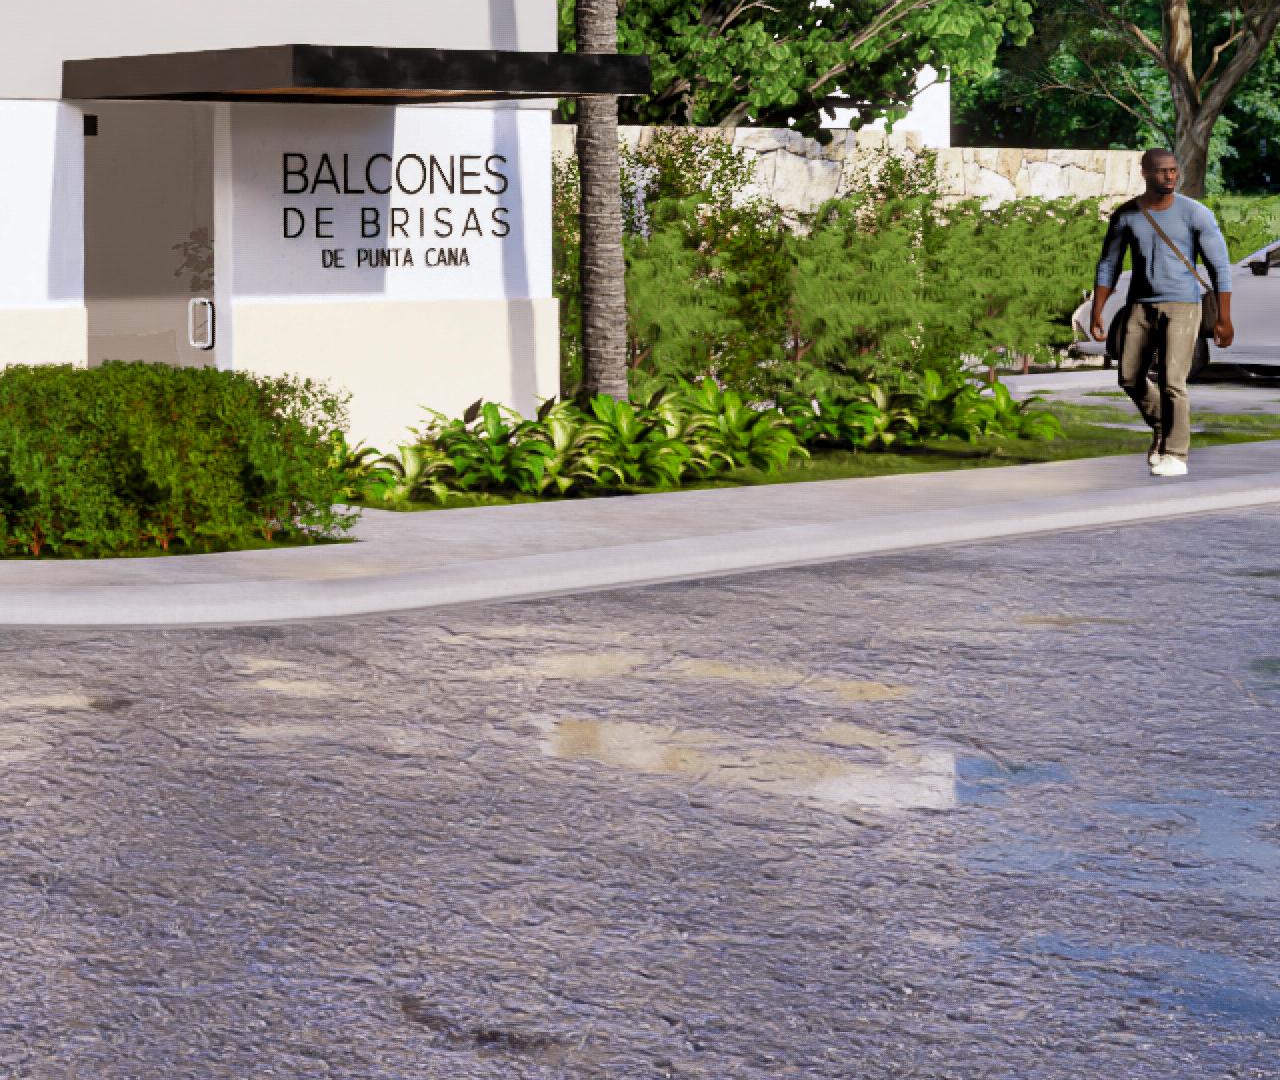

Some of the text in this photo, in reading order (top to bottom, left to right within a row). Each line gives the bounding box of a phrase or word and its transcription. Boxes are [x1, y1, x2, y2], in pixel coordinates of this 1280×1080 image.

[282, 153, 509, 195] BALCONES
[283, 207, 511, 239] DE BRISAS
[321, 247, 470, 268] DE PUNTA CANA
